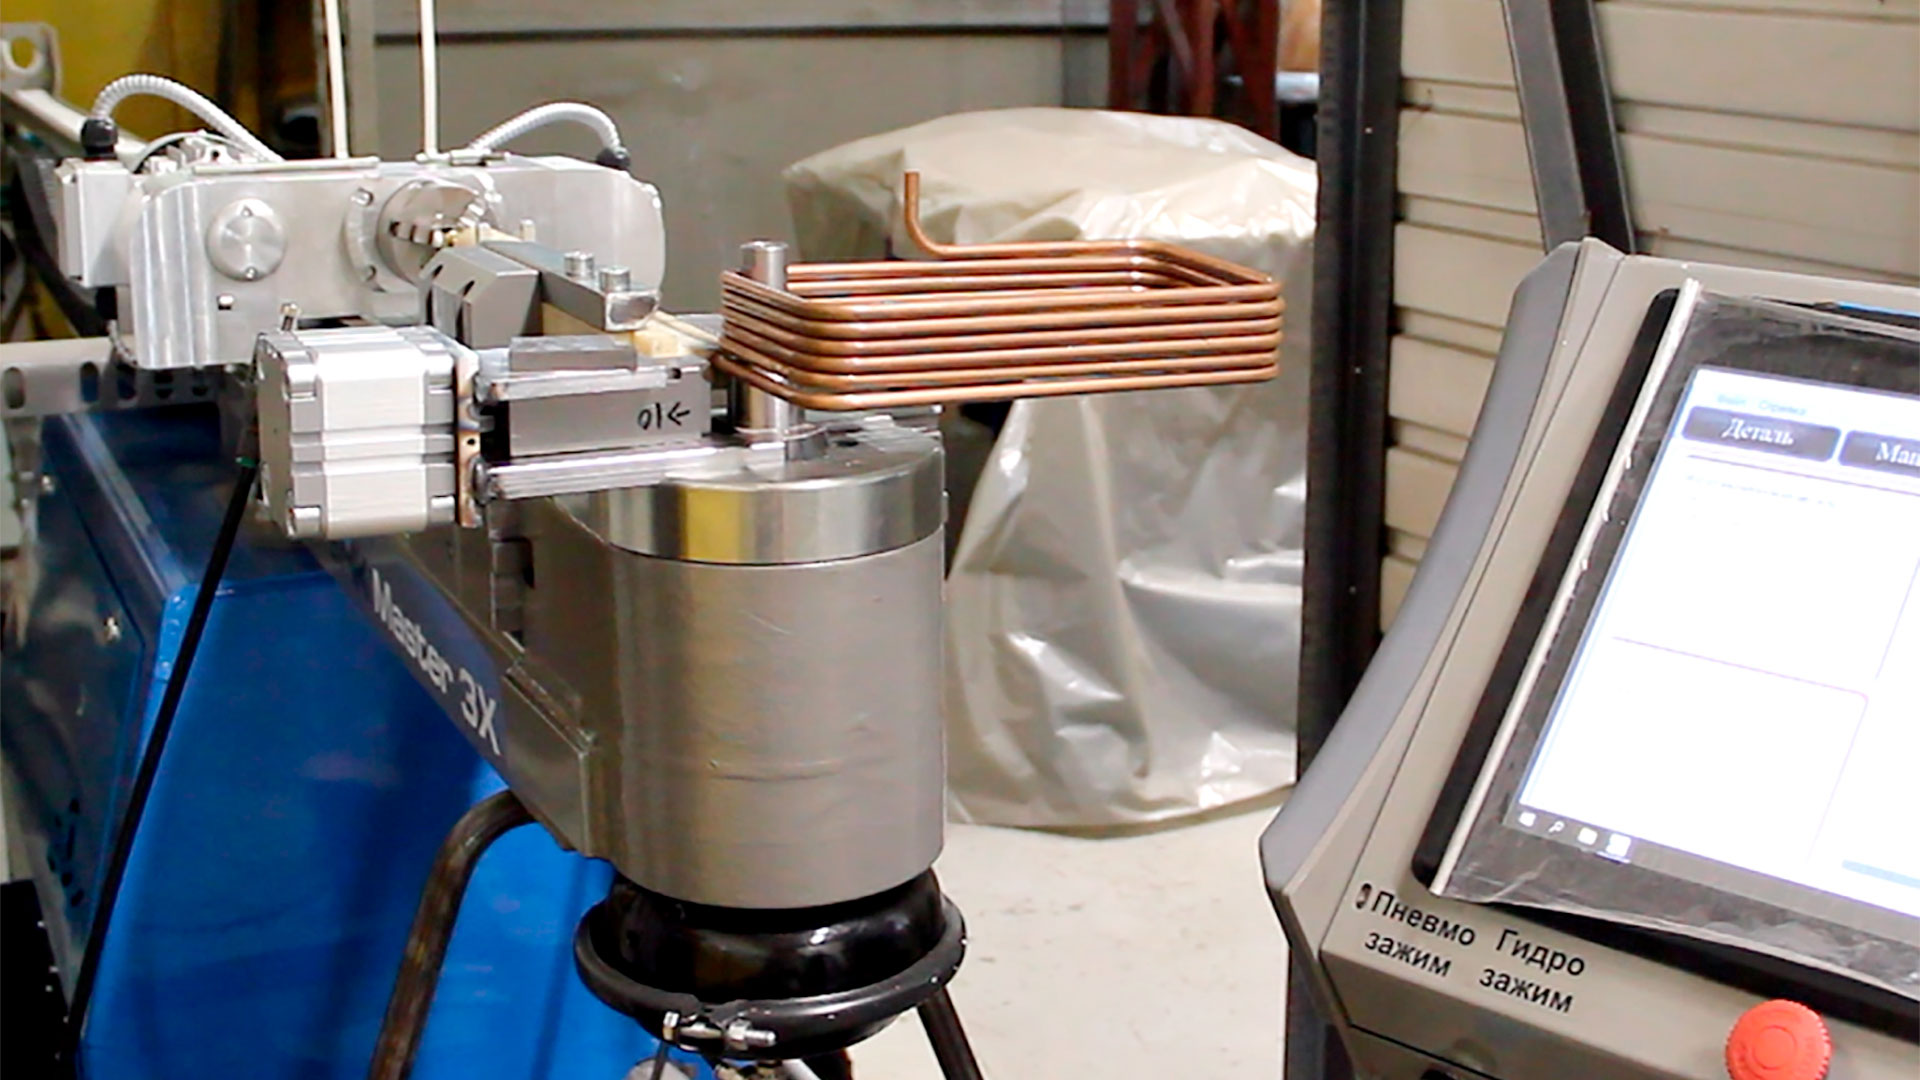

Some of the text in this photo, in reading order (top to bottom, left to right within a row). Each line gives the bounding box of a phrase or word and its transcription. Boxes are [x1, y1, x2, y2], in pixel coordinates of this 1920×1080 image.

[1721, 417, 1794, 446] Деталь
[372, 567, 501, 756] Master 3X
[1371, 890, 1476, 946] Пневмо
[1364, 931, 1452, 977] зажим
[1495, 928, 1586, 977] Гидро
[1479, 967, 1574, 1013] зажим
